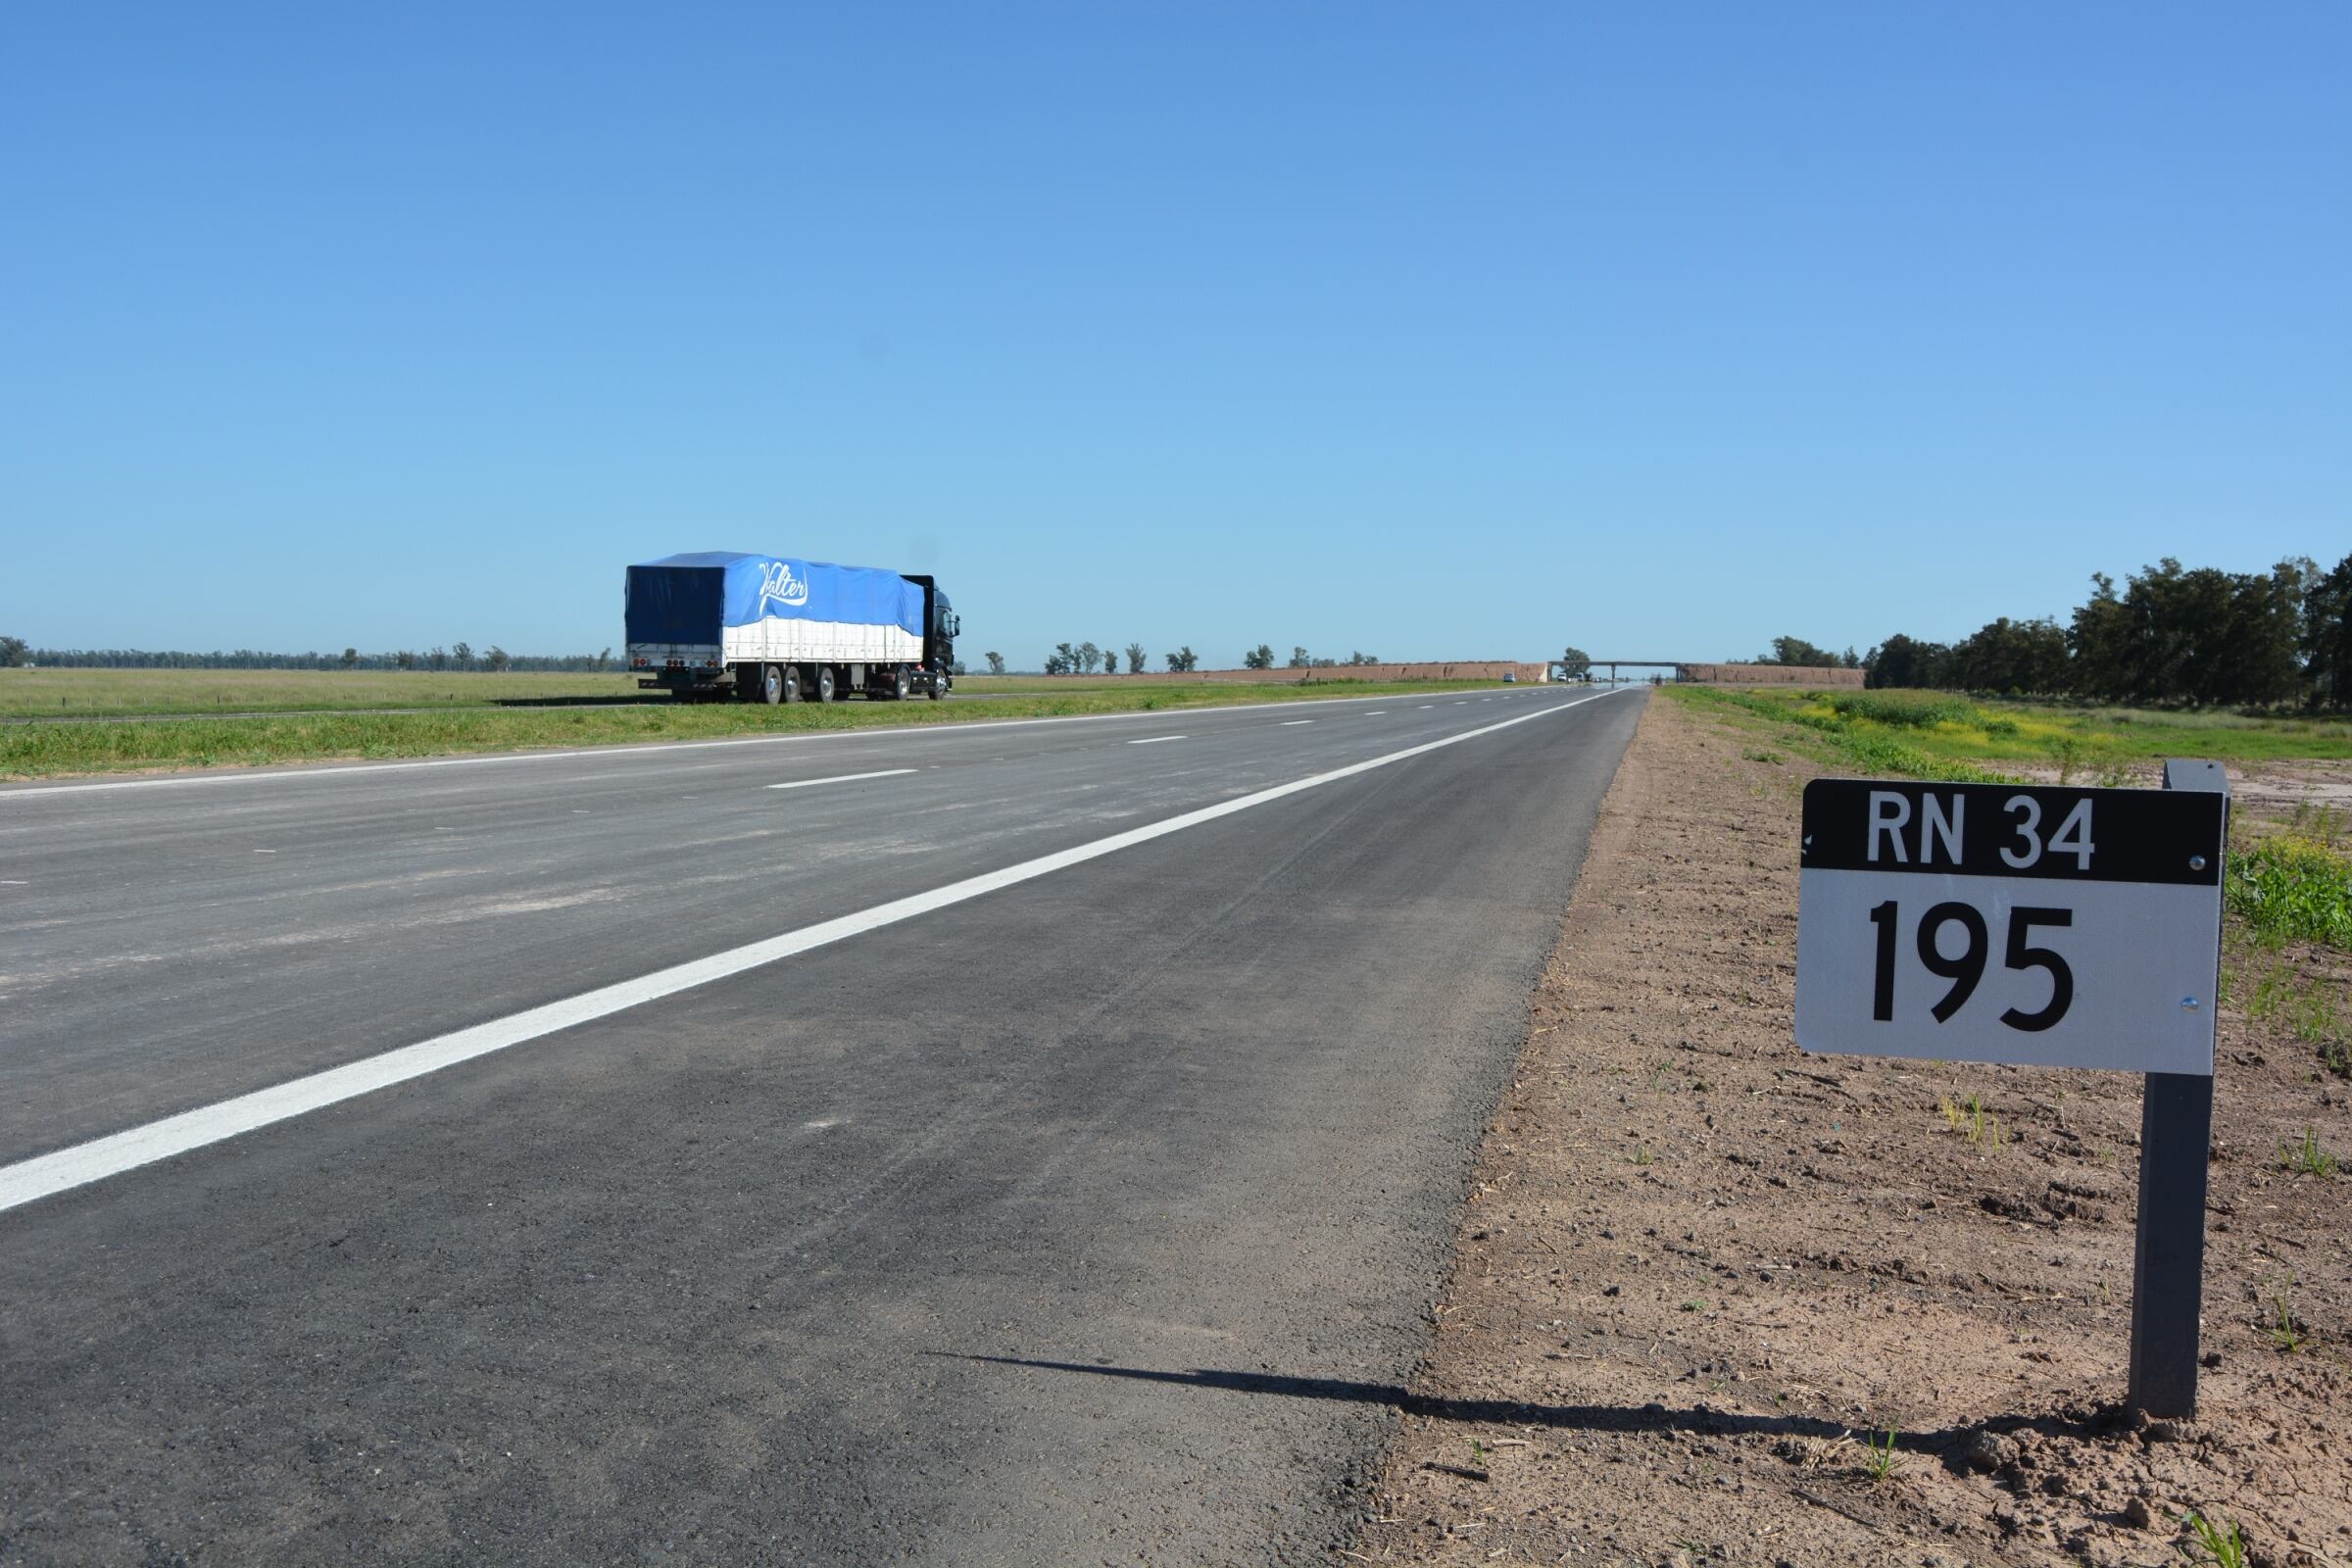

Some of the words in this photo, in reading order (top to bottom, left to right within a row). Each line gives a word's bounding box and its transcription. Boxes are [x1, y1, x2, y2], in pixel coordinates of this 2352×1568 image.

[1867, 790, 1965, 865] RN
[1999, 794, 2095, 871] 34
[1870, 900, 2074, 1033] 195
